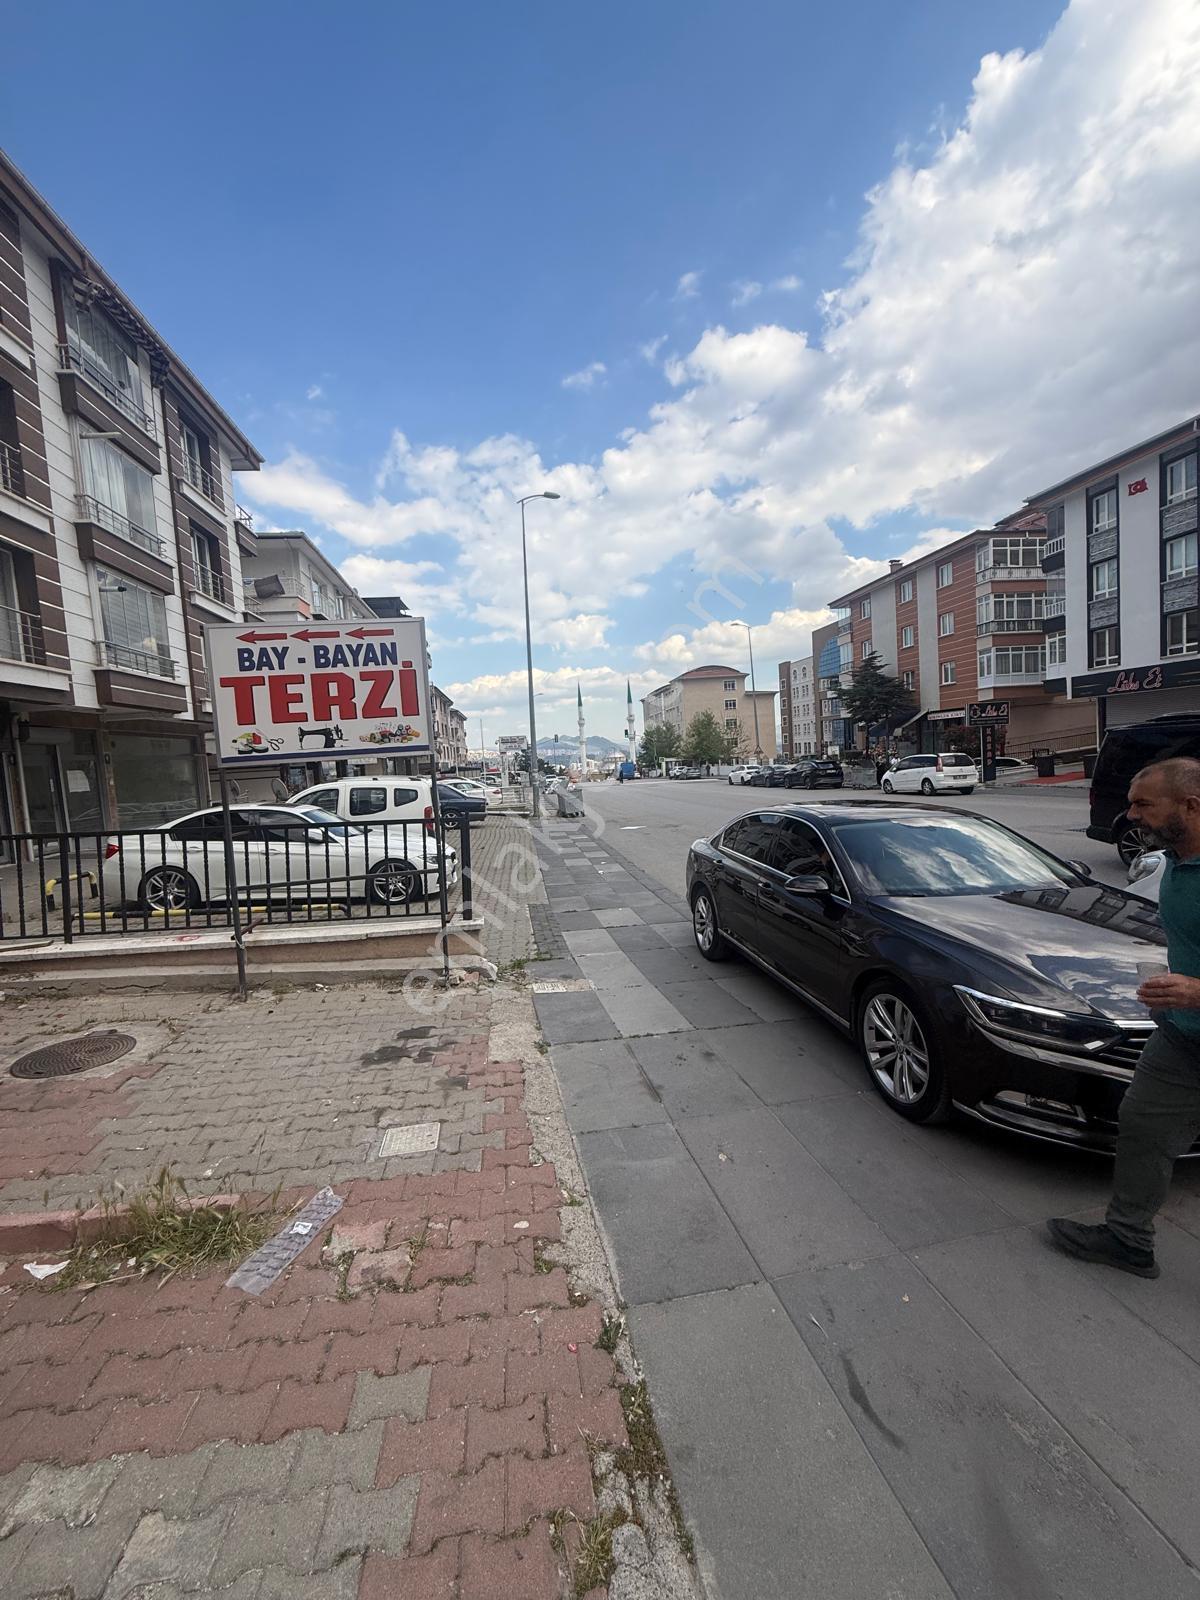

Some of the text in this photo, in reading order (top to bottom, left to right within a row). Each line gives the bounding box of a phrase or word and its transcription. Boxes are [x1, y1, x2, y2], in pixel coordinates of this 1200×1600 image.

[237, 646, 290, 672] BAY
[313, 641, 398, 669] BAYAN
[219, 660, 420, 726] TERZİ
